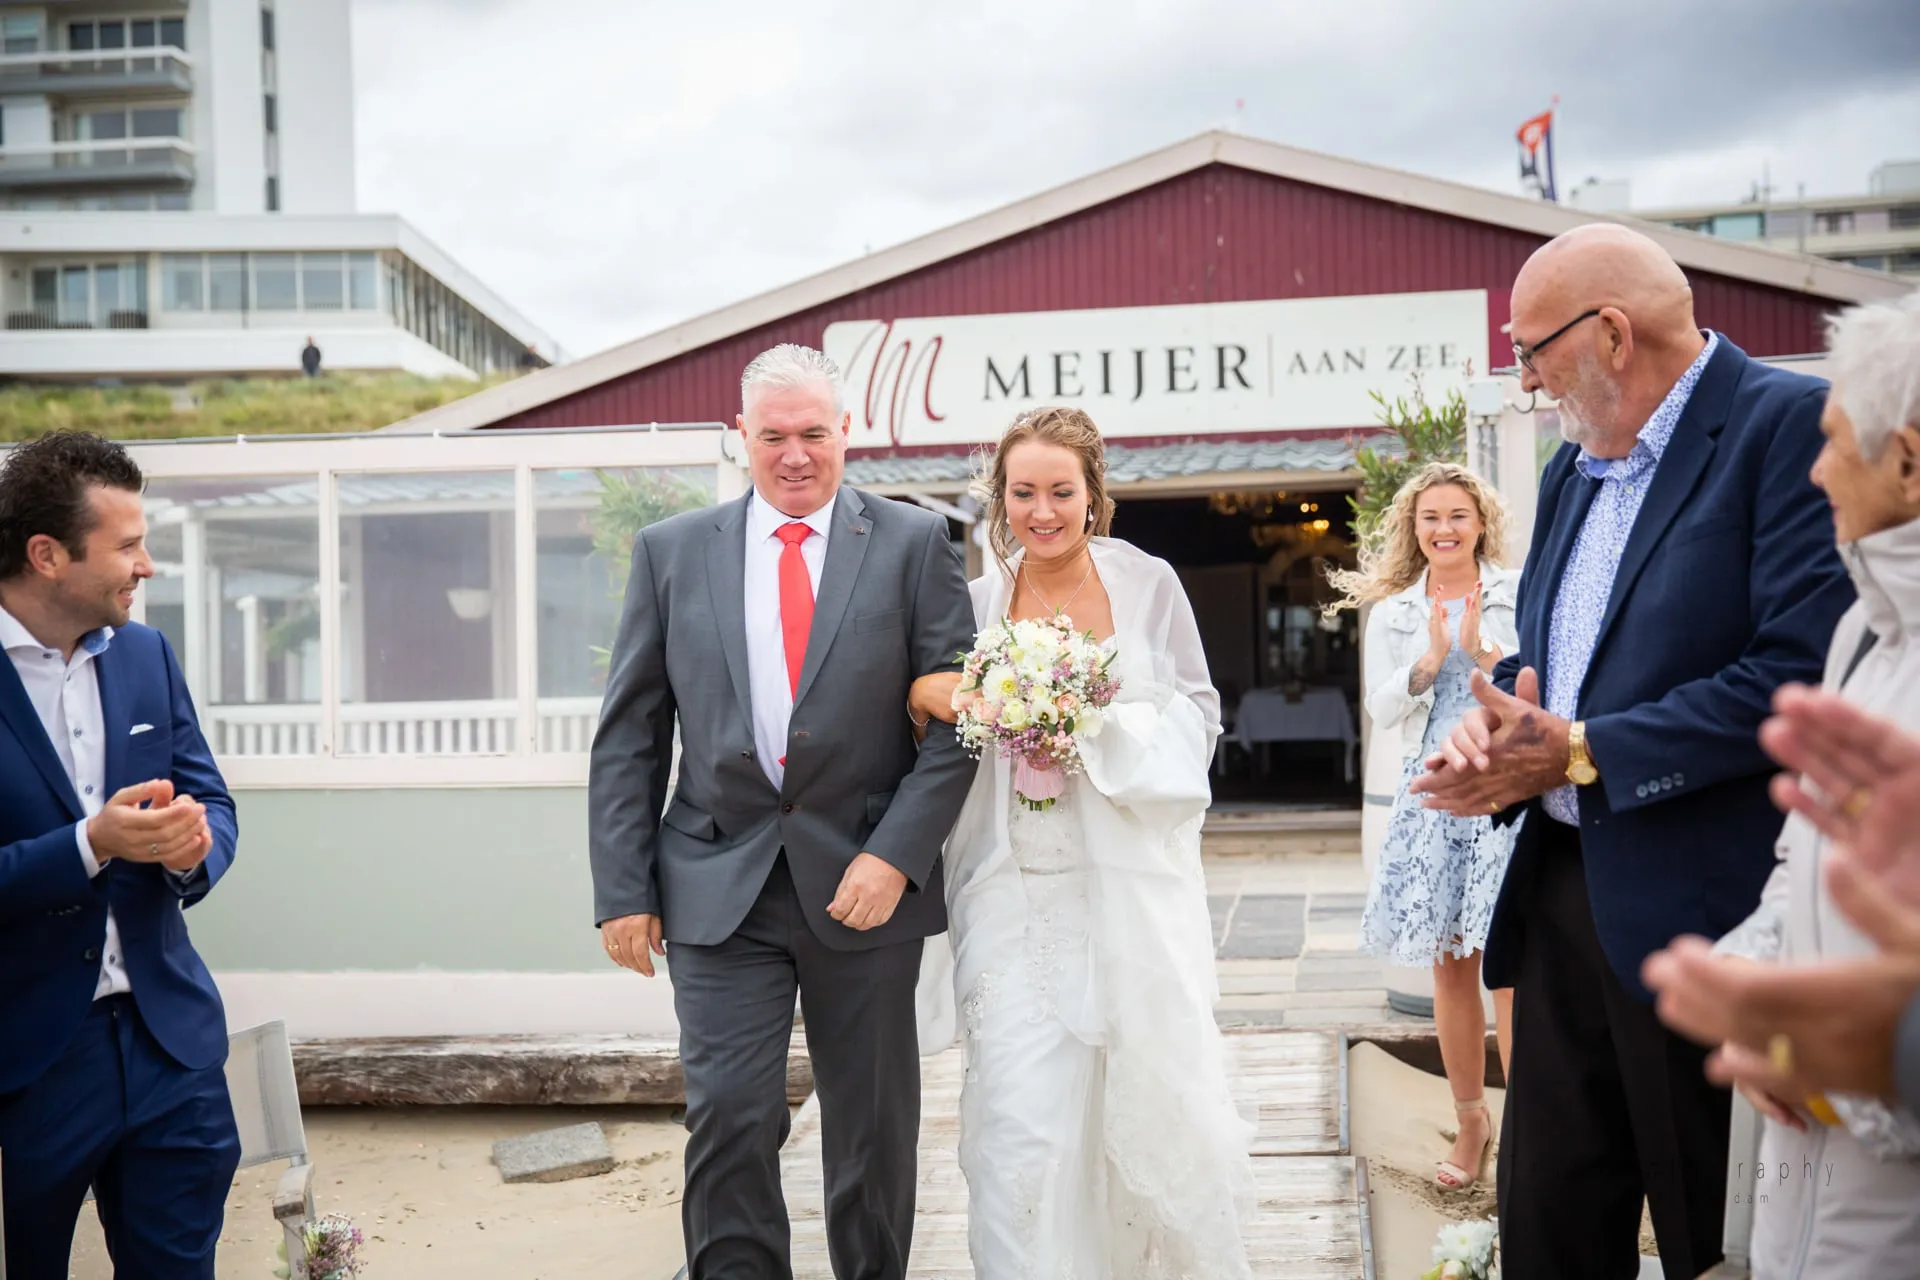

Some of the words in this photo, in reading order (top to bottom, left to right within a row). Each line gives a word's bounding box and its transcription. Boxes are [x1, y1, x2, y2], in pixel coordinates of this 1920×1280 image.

[982, 343, 1254, 403] MEIJER
[1287, 347, 1367, 376] AAN
[1387, 343, 1458, 372] ZEE
